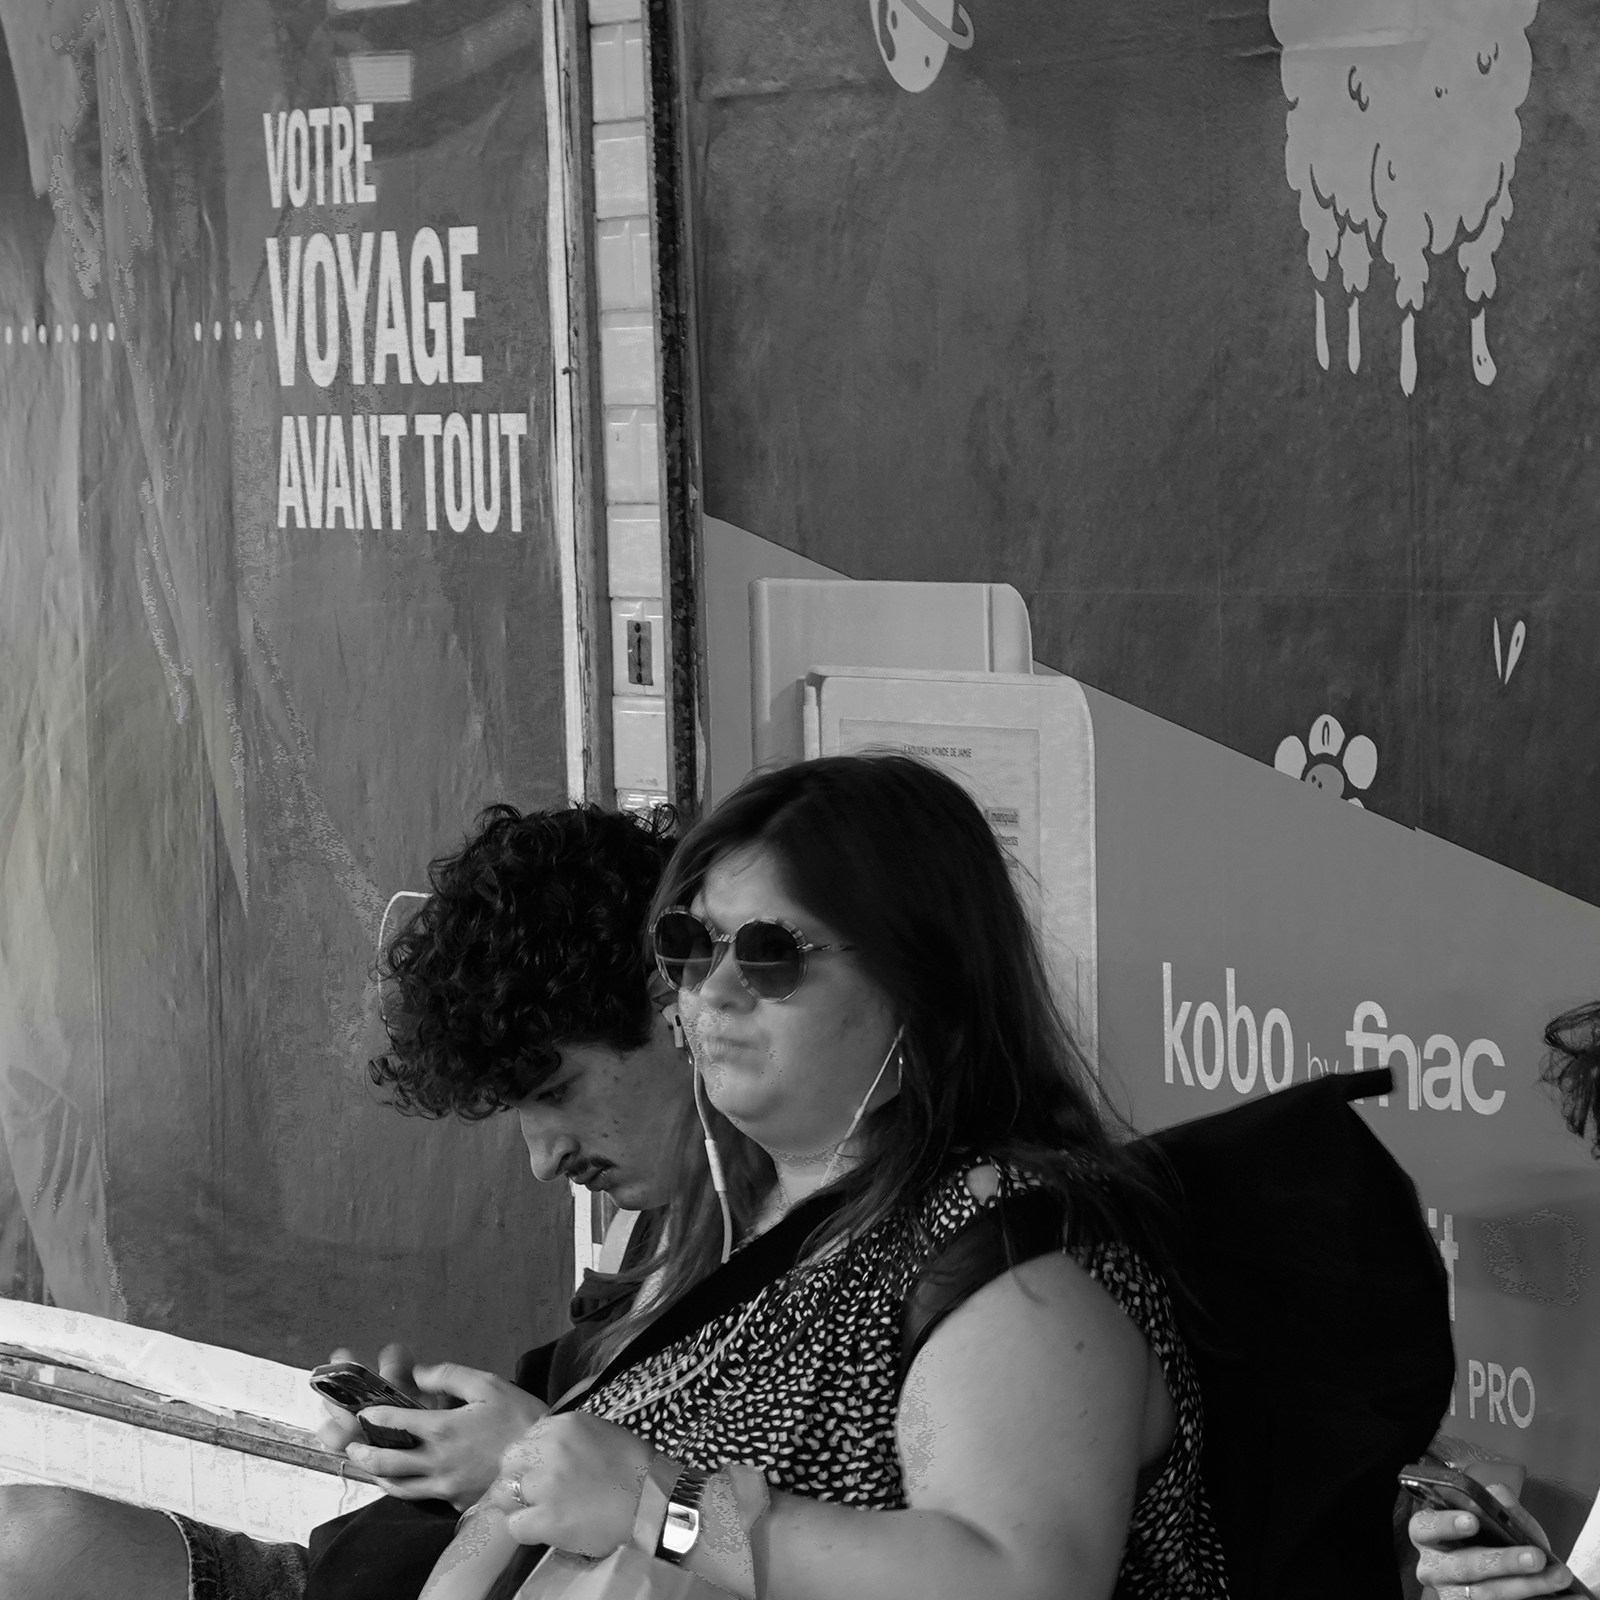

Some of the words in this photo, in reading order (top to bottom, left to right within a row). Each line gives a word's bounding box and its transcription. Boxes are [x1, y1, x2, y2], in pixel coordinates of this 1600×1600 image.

[263, 103, 377, 208] VOTRE
[266, 226, 483, 388] VOYAGE
[277, 413, 408, 530] AVANT
[414, 412, 528, 533] TOUT
[1161, 960, 1294, 1094] kobo
[1345, 999, 1505, 1116] fnac
[1468, 1359, 1537, 1429] PRO
